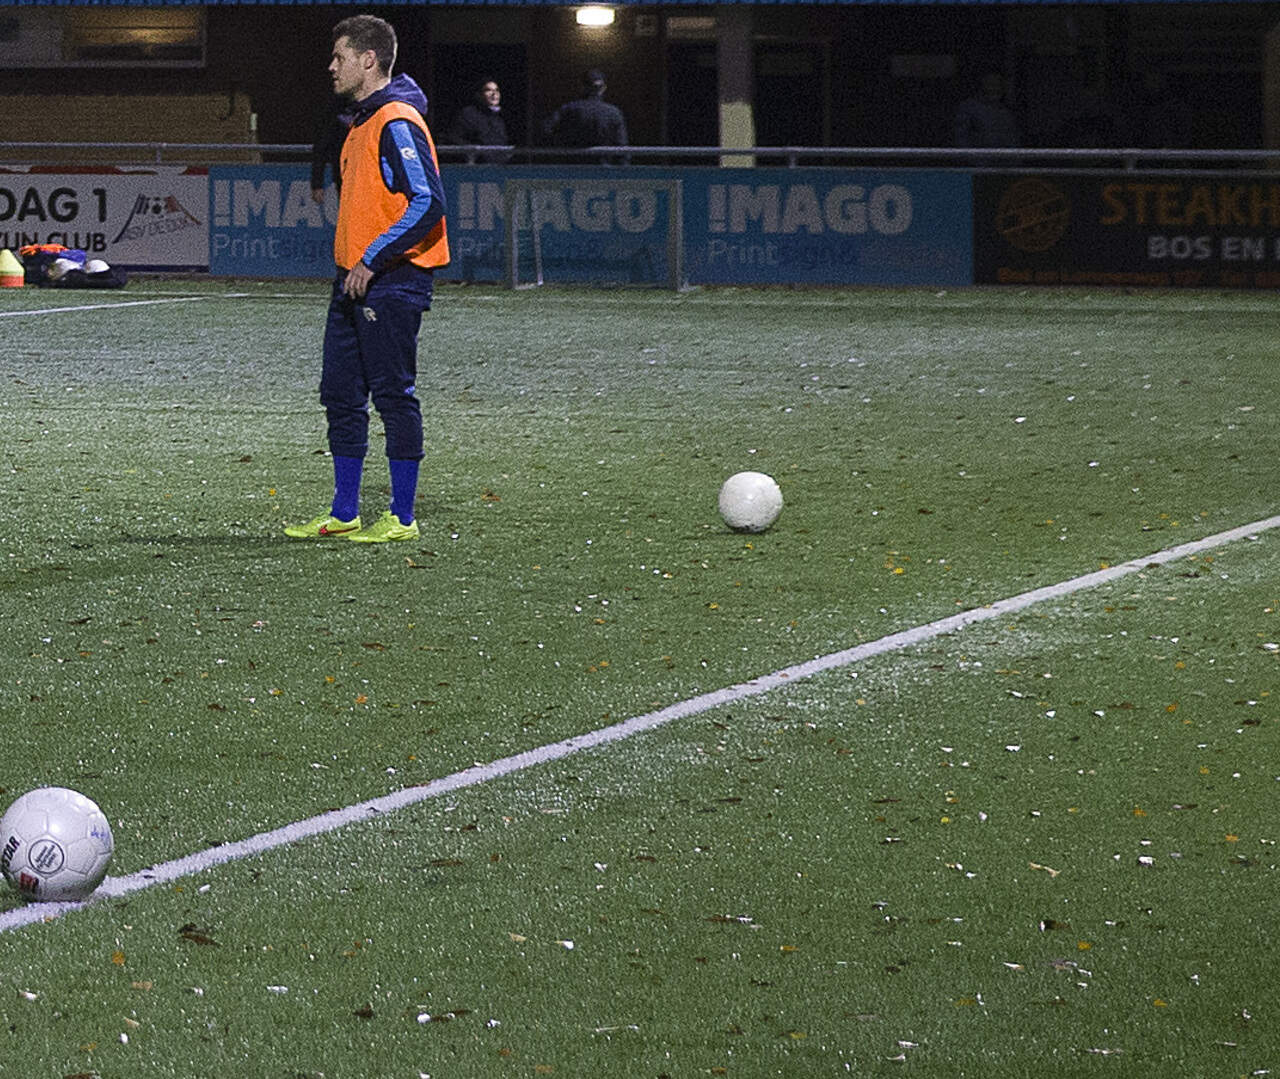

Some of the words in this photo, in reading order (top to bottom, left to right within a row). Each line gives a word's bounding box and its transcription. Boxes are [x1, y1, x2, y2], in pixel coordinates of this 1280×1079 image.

[92, 187, 108, 223] 1
[46, 232, 108, 253] CLUB
[1147, 234, 1212, 260] BOS
[1221, 235, 1266, 261] EN
